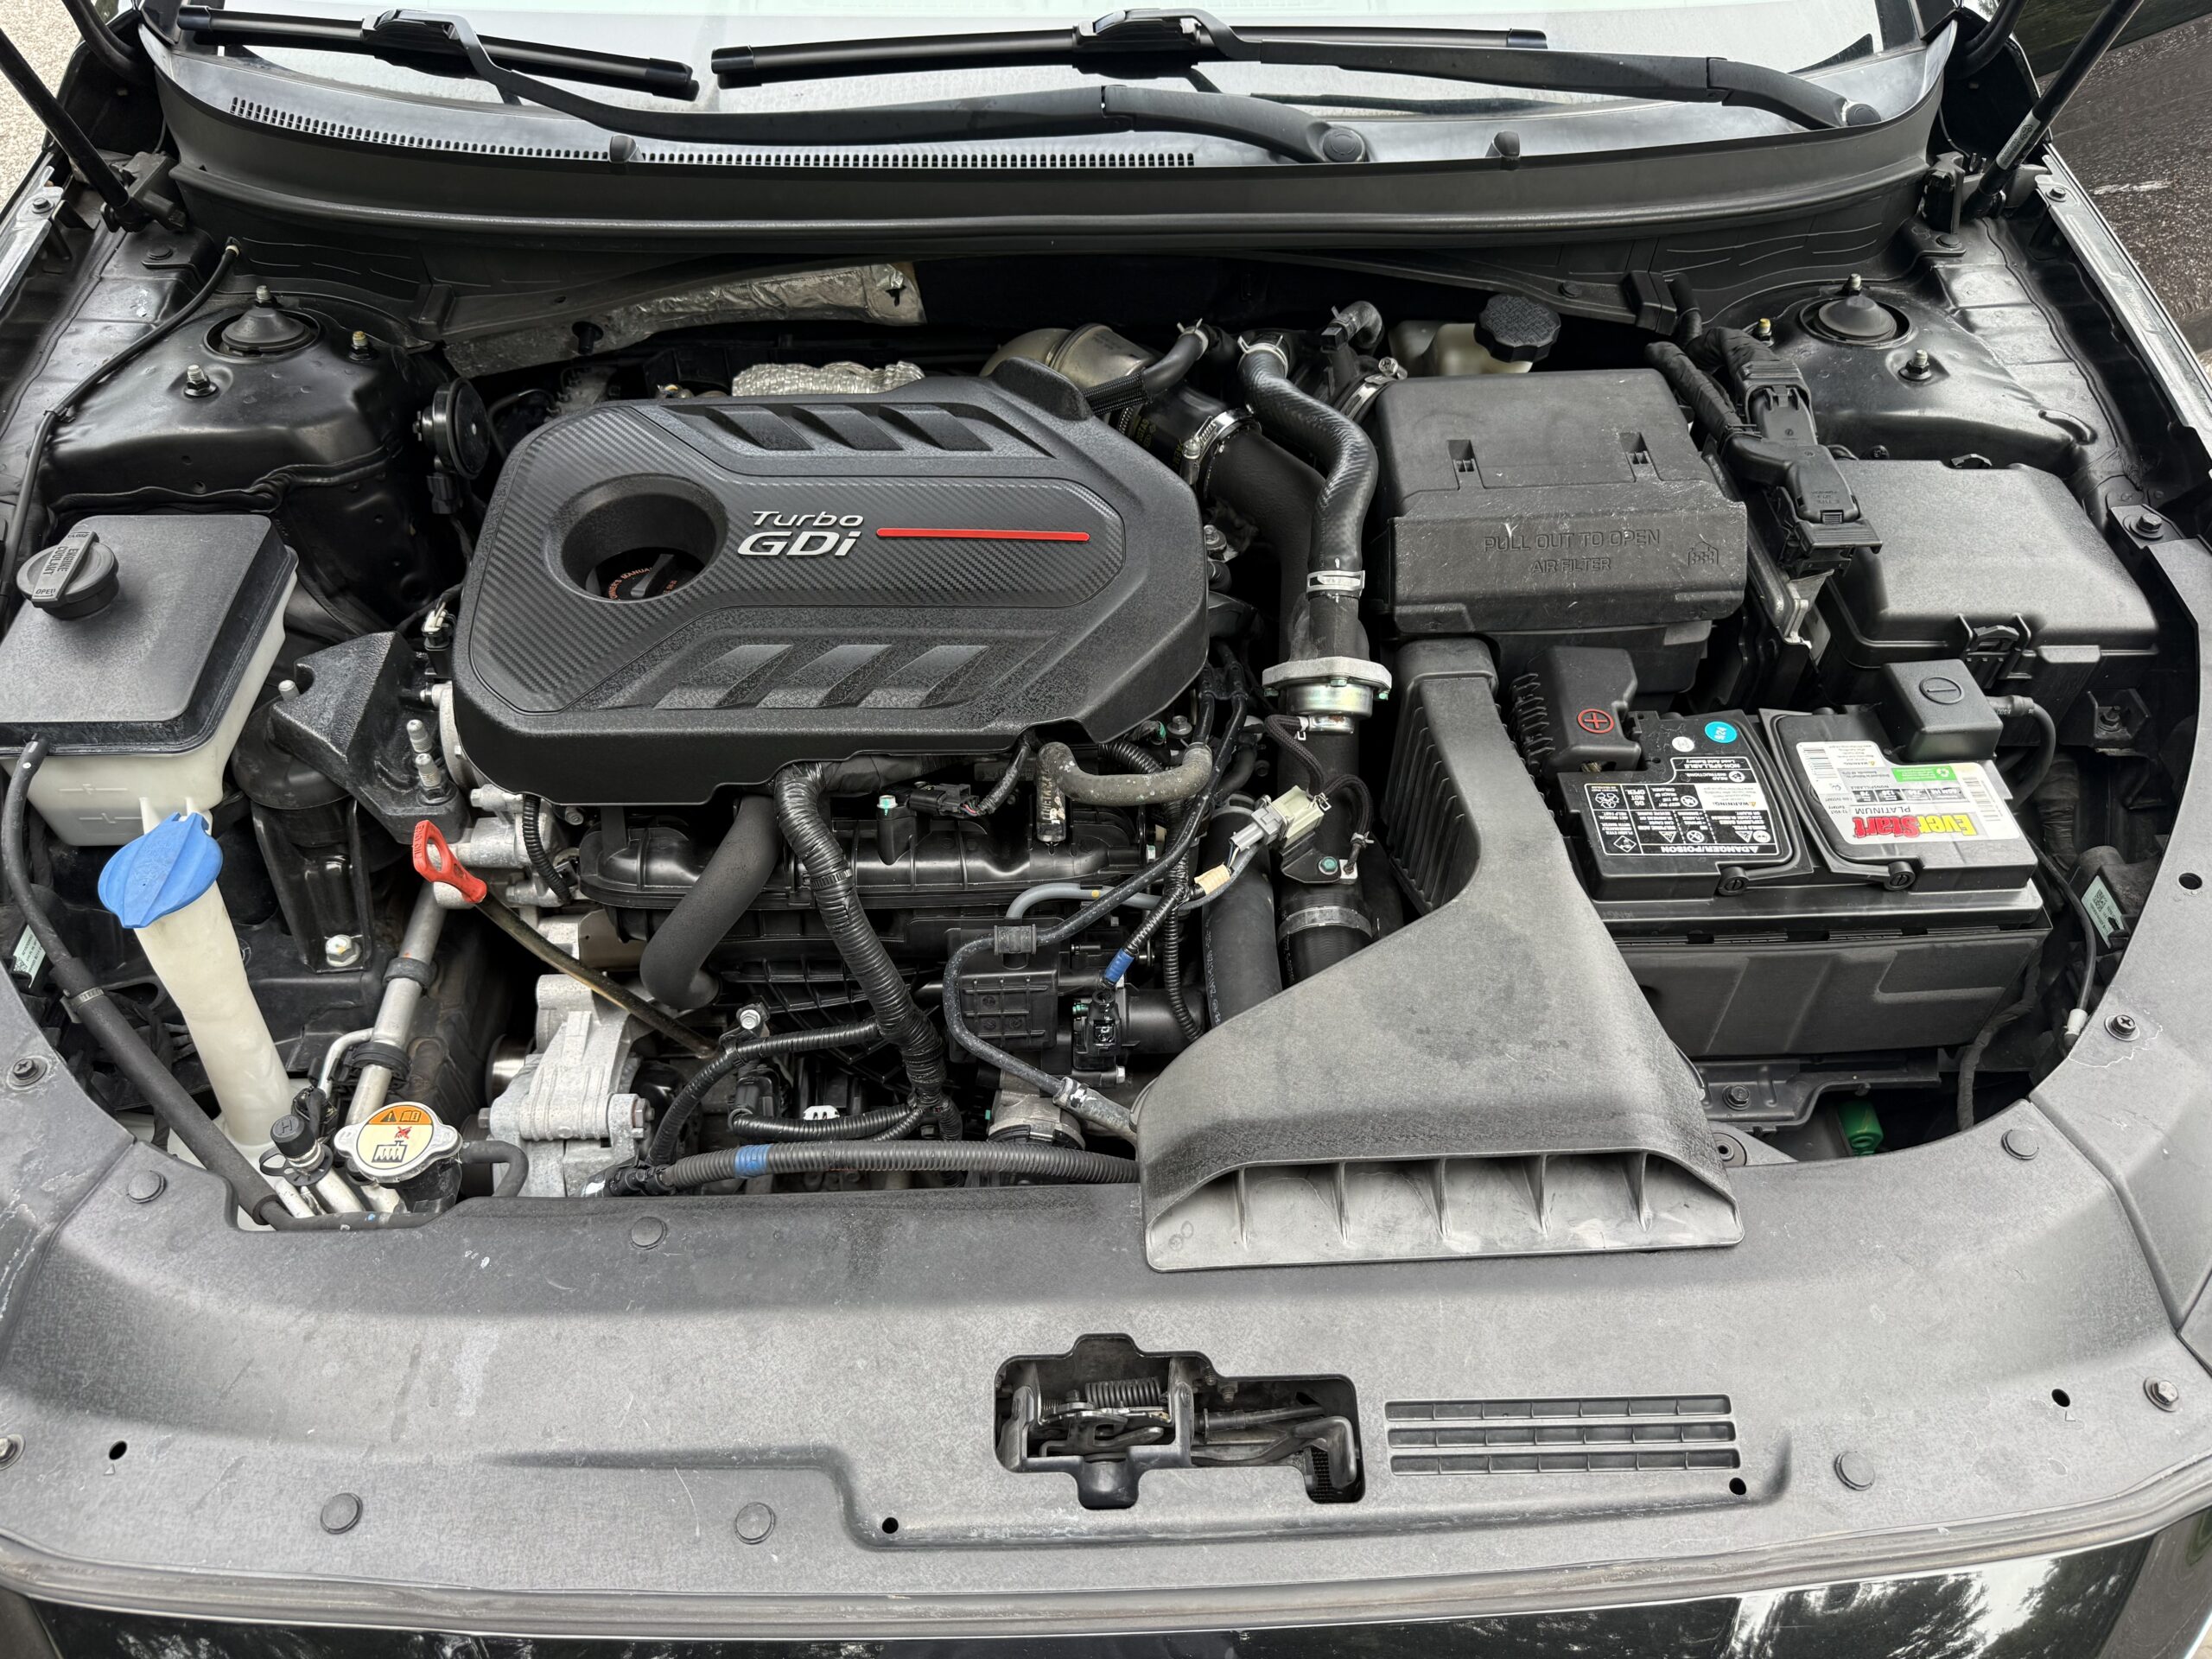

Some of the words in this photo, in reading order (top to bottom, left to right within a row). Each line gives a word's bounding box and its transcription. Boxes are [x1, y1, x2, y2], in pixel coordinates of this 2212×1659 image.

[753, 510, 864, 528] Turbo
[737, 531, 861, 557] GDi
[1484, 535, 1531, 552] PULL
[1535, 532, 1573, 550] OUT
[1578, 531, 1604, 549] TO
[1609, 528, 1661, 547] OPEN
[620, 568, 652, 579] MANUA
[1531, 558, 1560, 574] AIR
[1561, 556, 1611, 572] FILTER
[1853, 814, 1977, 838] EverStart
